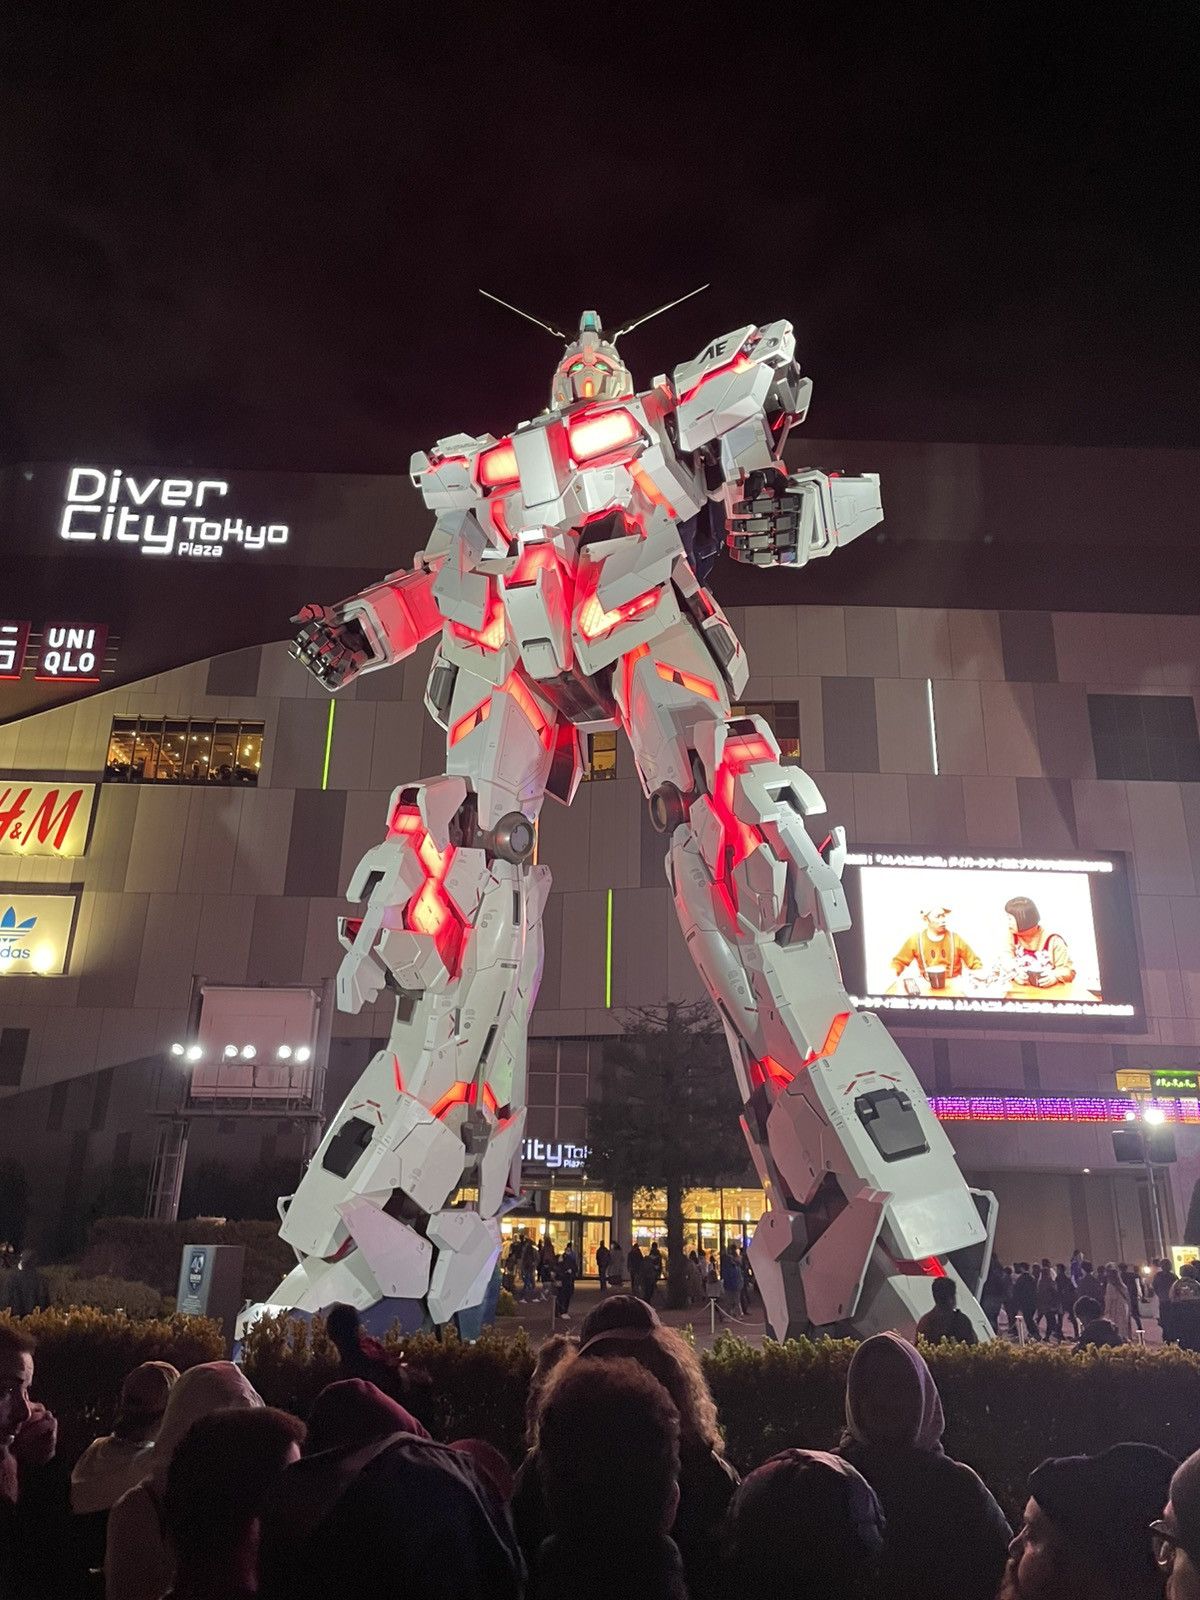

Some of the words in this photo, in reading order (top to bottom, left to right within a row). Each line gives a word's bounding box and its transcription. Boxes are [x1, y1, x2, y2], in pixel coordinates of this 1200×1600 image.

[66, 468, 229, 507] Diver
[60, 505, 177, 554] City
[178, 542, 223, 557] Plaza
[48, 627, 96, 650] UNI
[44, 651, 95, 675] QLO
